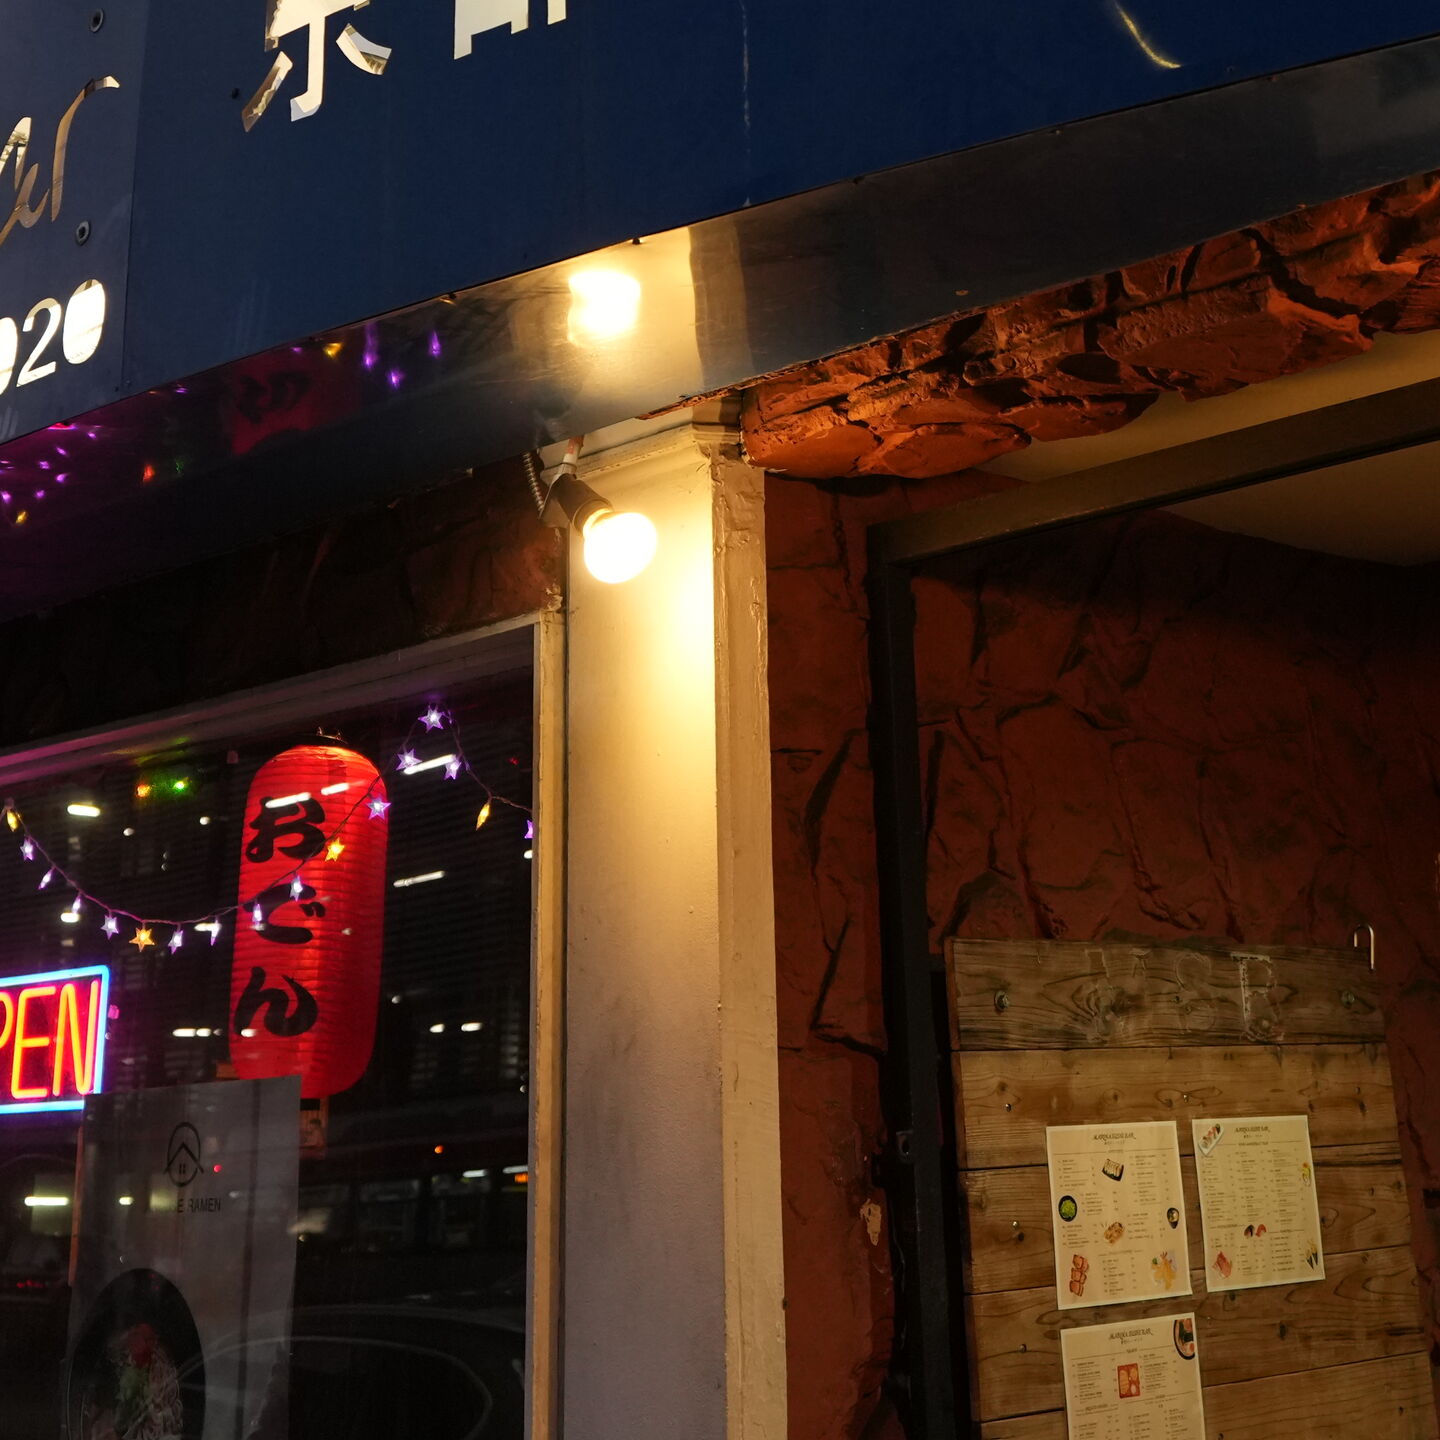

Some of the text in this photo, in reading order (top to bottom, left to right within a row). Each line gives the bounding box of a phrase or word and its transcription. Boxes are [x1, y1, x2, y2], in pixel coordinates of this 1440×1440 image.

[234, 795, 327, 1037] おでん
[188, 1198, 221, 1212] RAMEN
